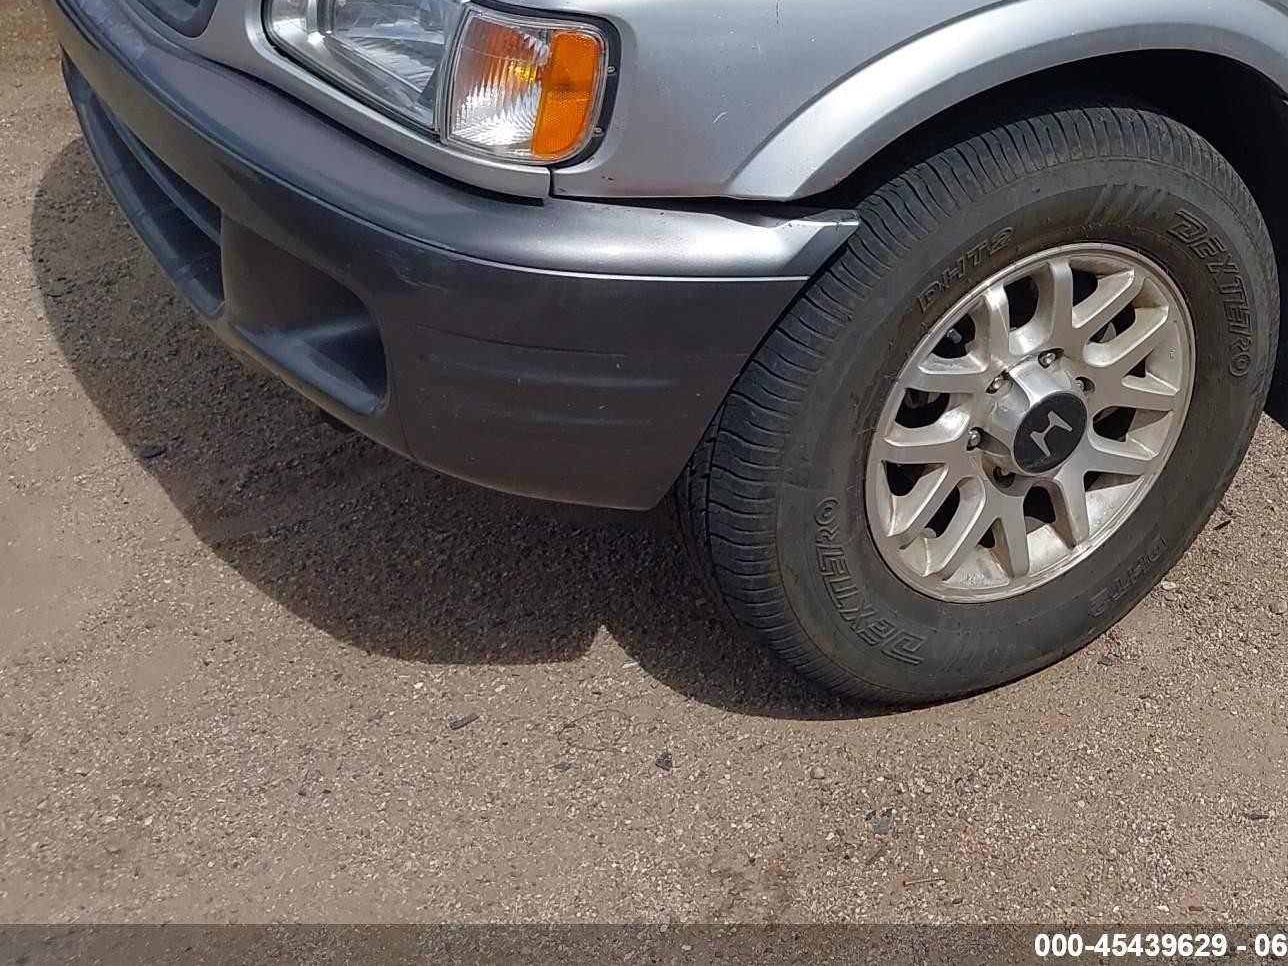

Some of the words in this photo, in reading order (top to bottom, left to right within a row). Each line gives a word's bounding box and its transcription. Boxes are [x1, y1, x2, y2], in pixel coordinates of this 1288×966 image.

[916, 225, 1014, 314] DHT2
[1166, 208, 1253, 377] DEXTERO
[814, 495, 928, 667] DEXTERO
